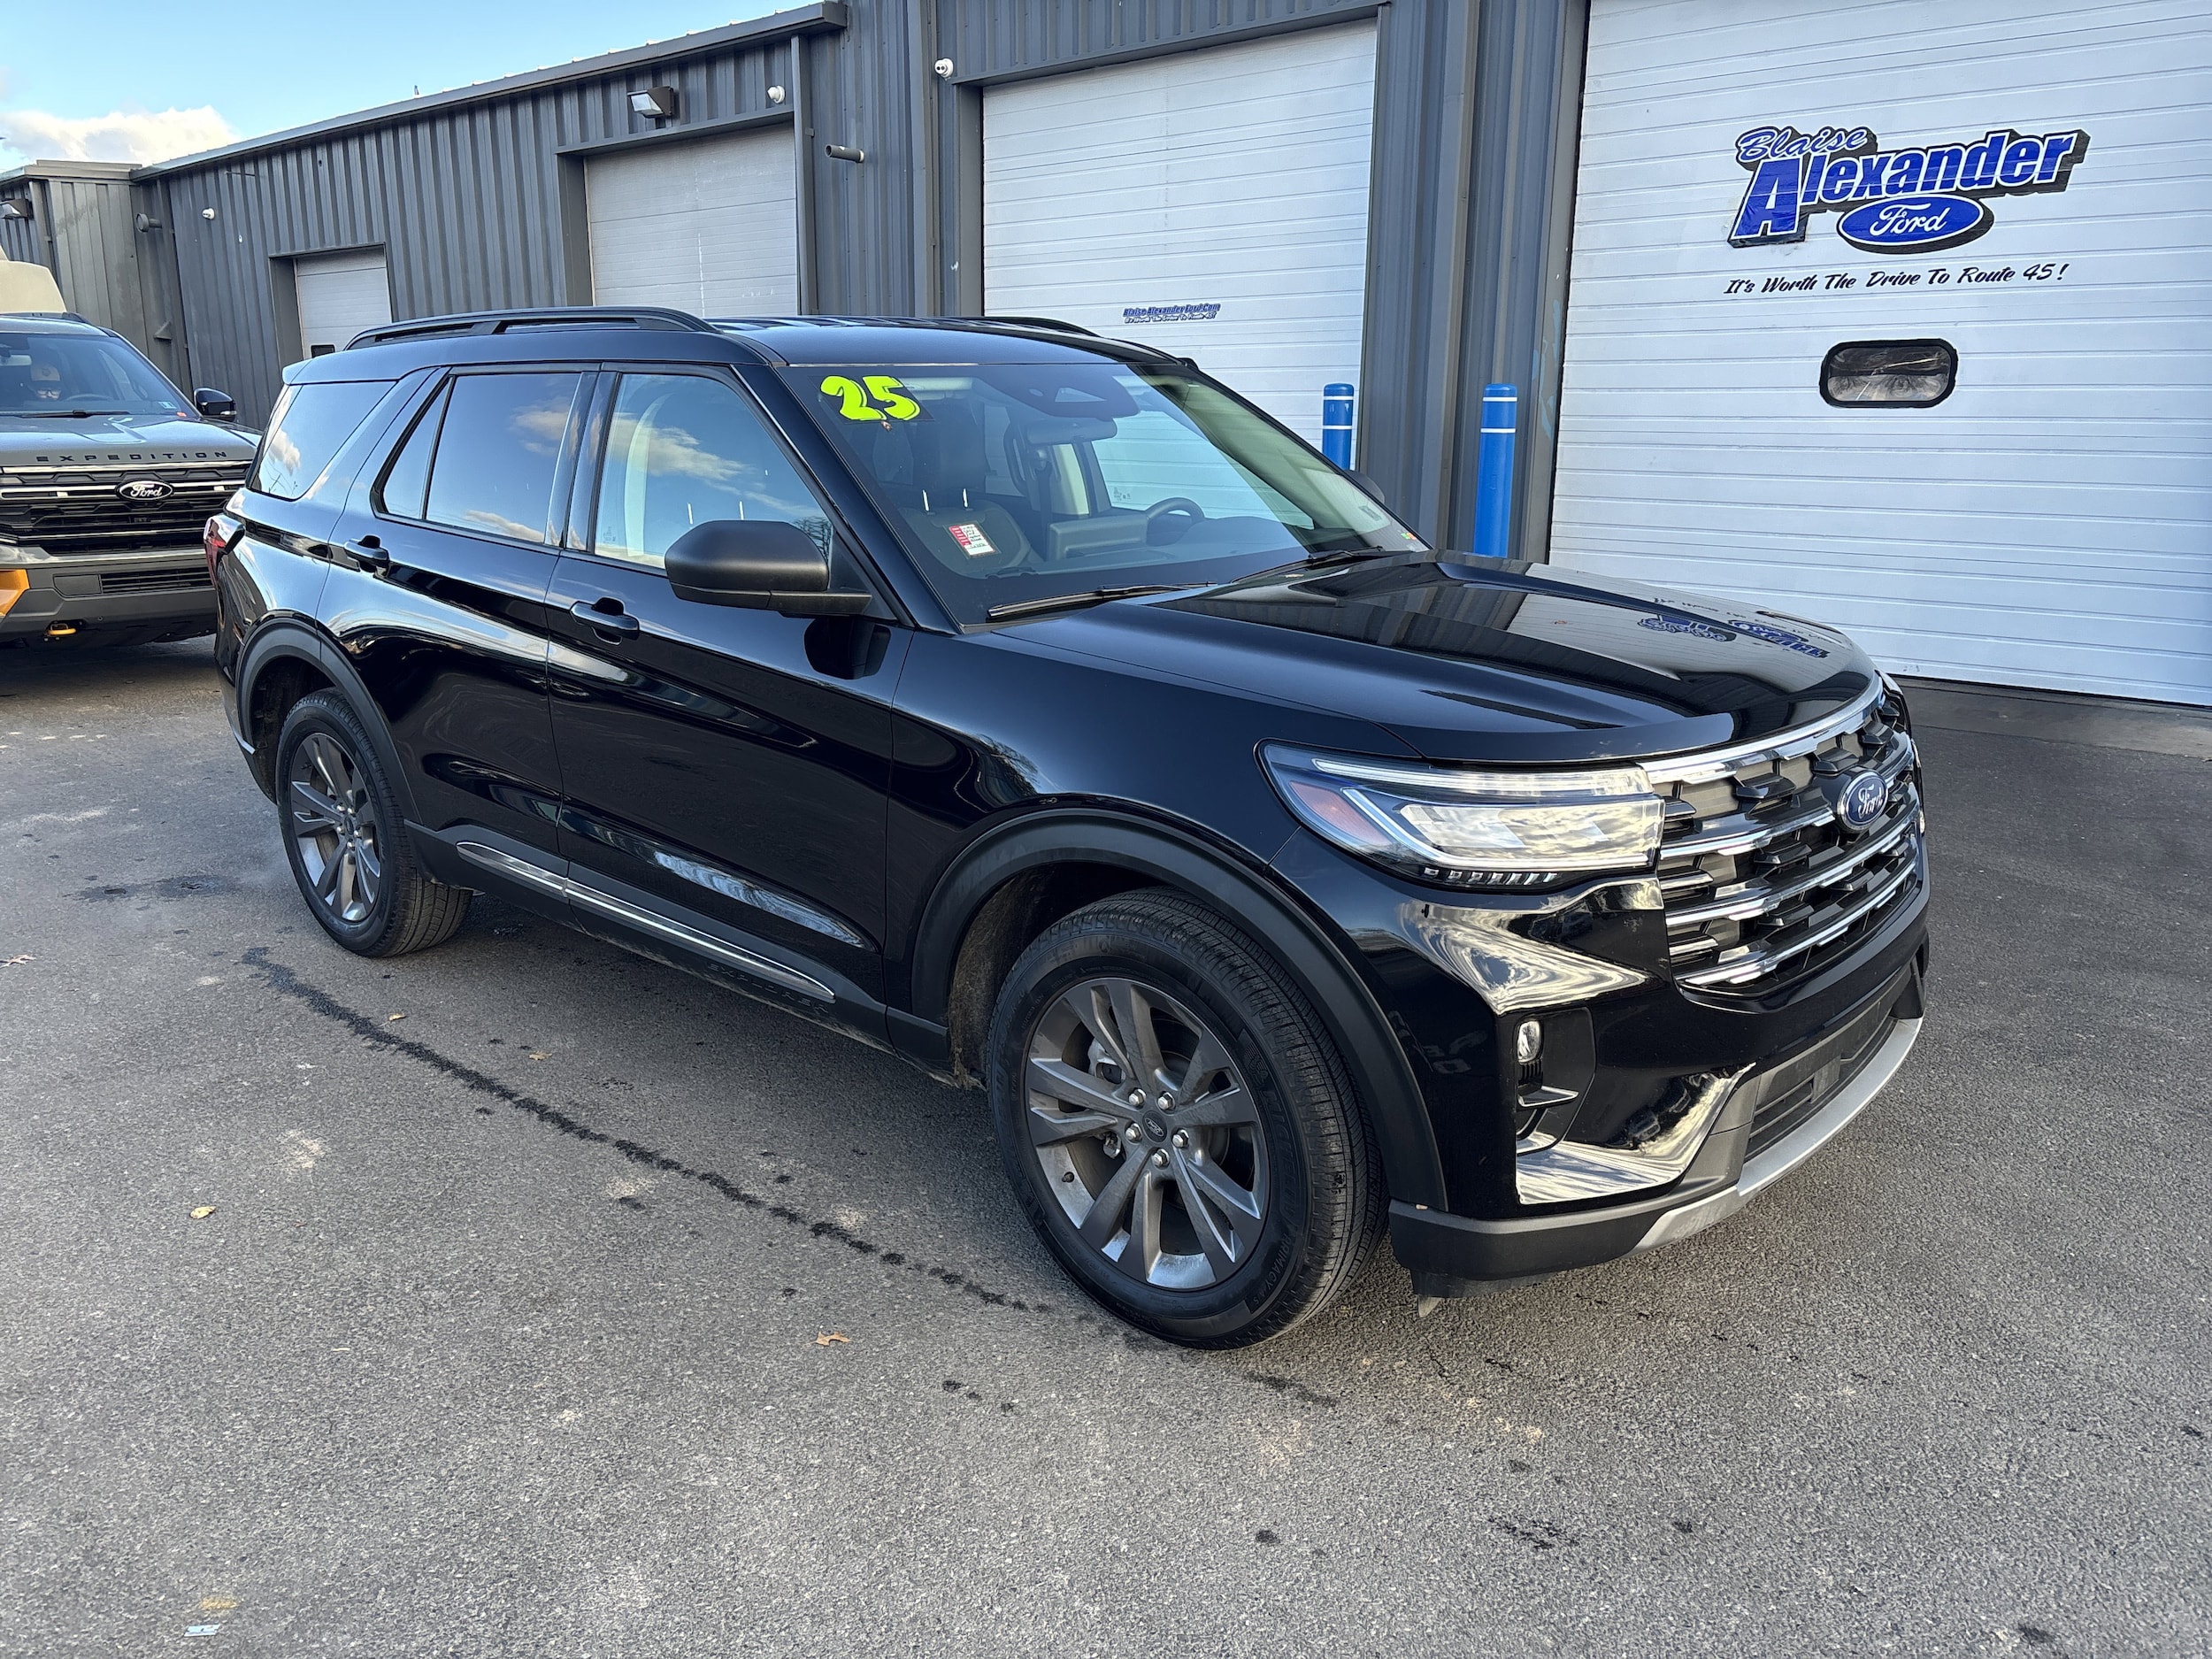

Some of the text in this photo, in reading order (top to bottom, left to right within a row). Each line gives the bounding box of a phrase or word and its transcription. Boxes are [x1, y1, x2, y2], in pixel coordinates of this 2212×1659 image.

[1738, 127, 1869, 162] Blaise
[1731, 131, 2079, 239] Alexander
[1869, 203, 1951, 236] Ford
[1724, 278, 1756, 295] It's
[1761, 274, 1817, 294] Worth
[1824, 272, 1857, 290] The
[1866, 270, 1922, 288] Drive
[1928, 267, 1950, 285] To
[1957, 266, 2016, 284] Route
[820, 376, 921, 421] 25
[36, 451, 227, 463] EXPEDITION
[130, 483, 163, 497] Ford
[1858, 784, 1884, 819] Ford
[1265, 1233, 1292, 1291] PRIMACY
